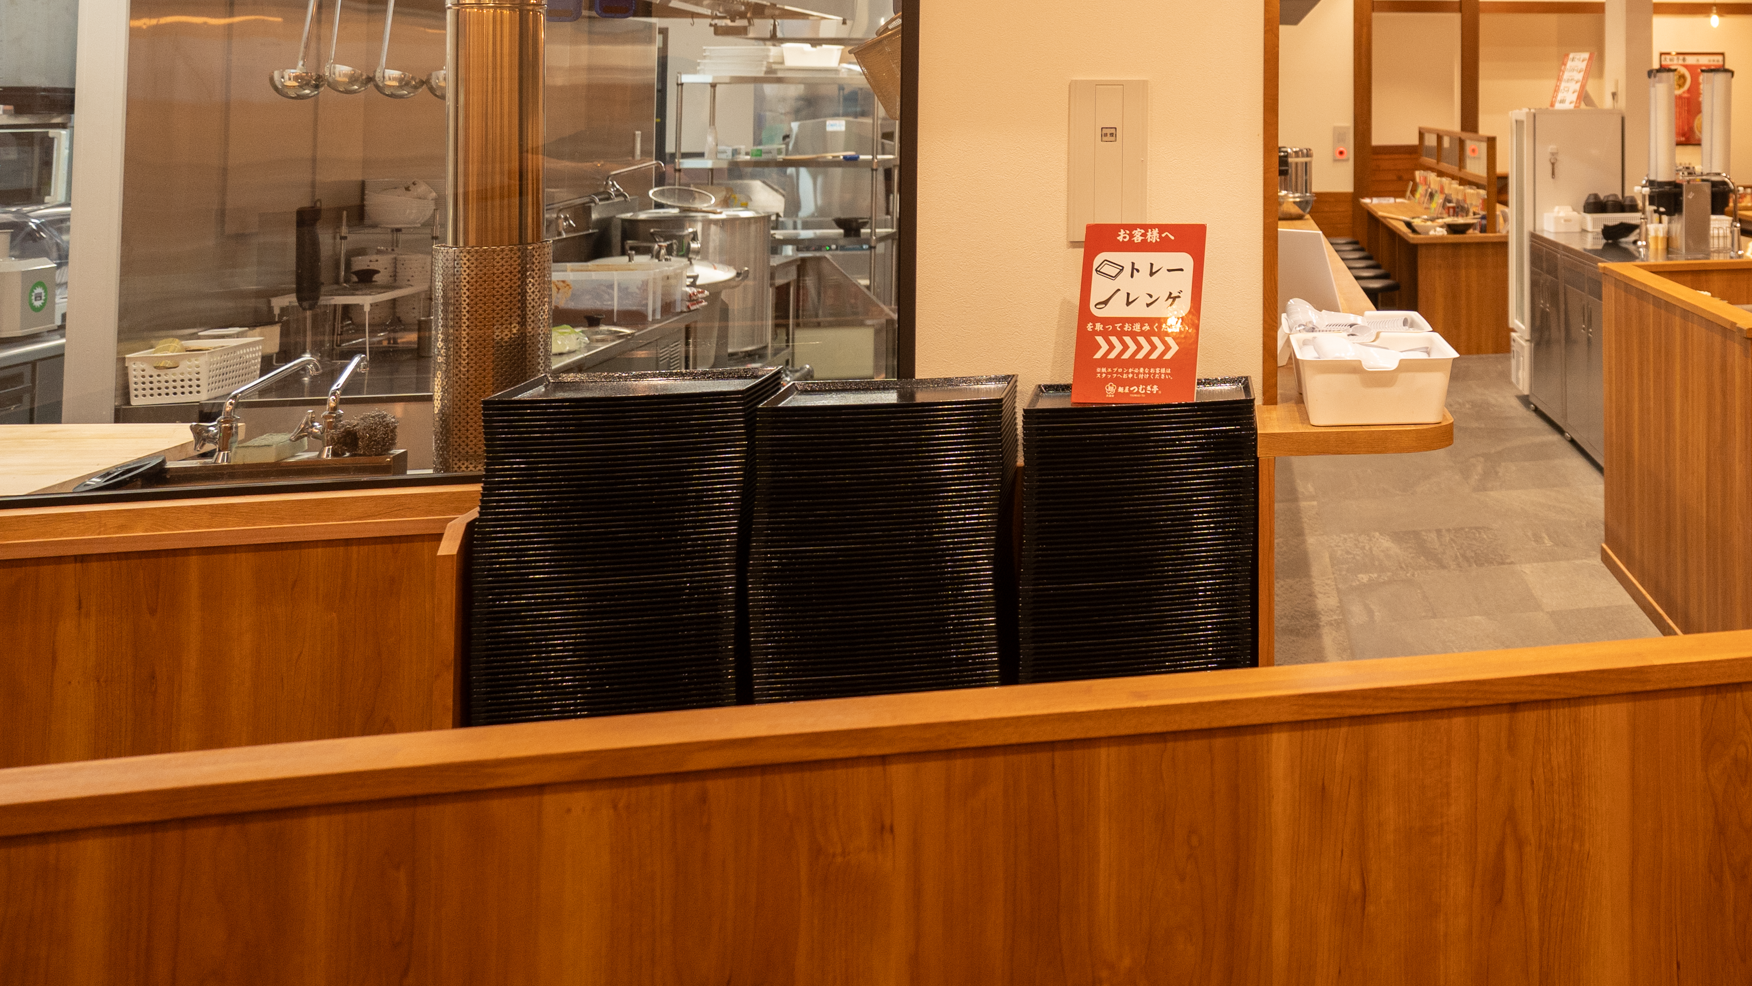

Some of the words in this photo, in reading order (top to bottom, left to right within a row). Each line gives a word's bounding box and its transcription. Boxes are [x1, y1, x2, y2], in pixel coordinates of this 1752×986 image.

[1117, 228, 1175, 243] お客様へ
[1130, 261, 1185, 279] トレー
[1125, 289, 1184, 309] レンゲ
[1086, 322, 1192, 332] を取ってお進みくだい。
